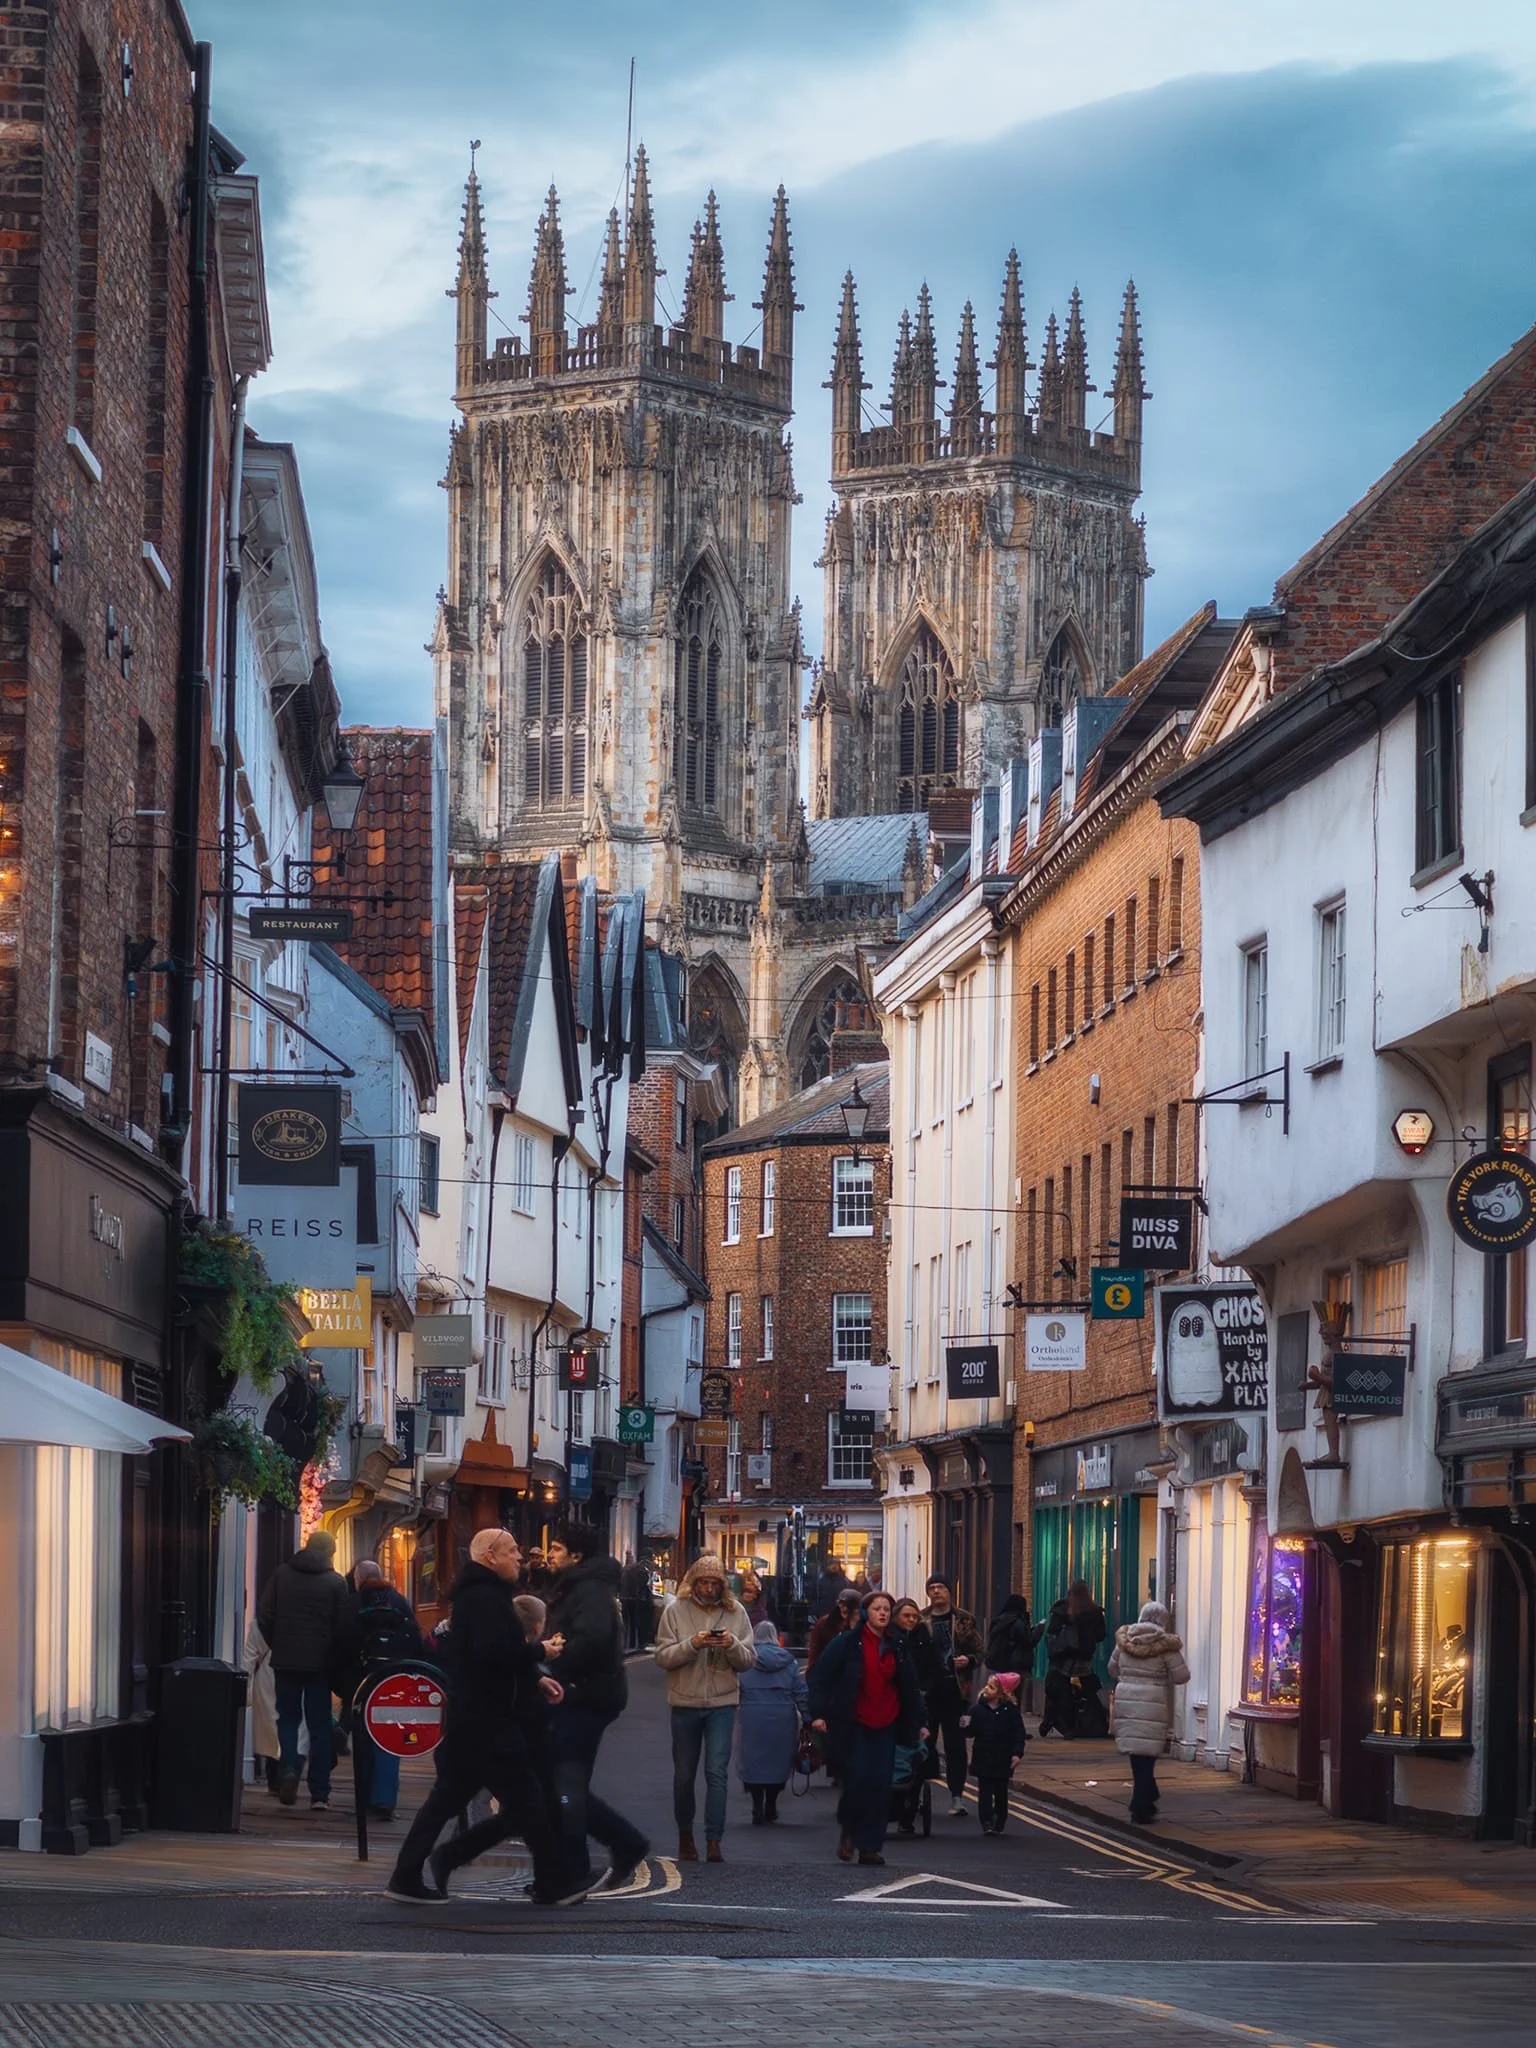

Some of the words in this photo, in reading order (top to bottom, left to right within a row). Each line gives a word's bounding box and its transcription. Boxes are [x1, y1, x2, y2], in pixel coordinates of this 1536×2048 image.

[262, 920, 340, 929] RESTAURANT
[264, 1112, 315, 1124] DRAKE'S
[1457, 1178, 1473, 1202] THE
[1467, 1161, 1500, 1180] YORK
[1501, 1161, 1536, 1187] ROAST
[247, 1218, 343, 1237] REISS
[1132, 1218, 1180, 1233] MISS
[1132, 1235, 1178, 1250] DIVA
[307, 1293, 363, 1311] BELLA
[422, 1335, 465, 1343] WILDWOOD
[1031, 1345, 1080, 1354] Orthokind
[1247, 1344, 1262, 1360] by
[1334, 1394, 1402, 1405] SILVARIOUS
[622, 1431, 651, 1441] OXFAM
